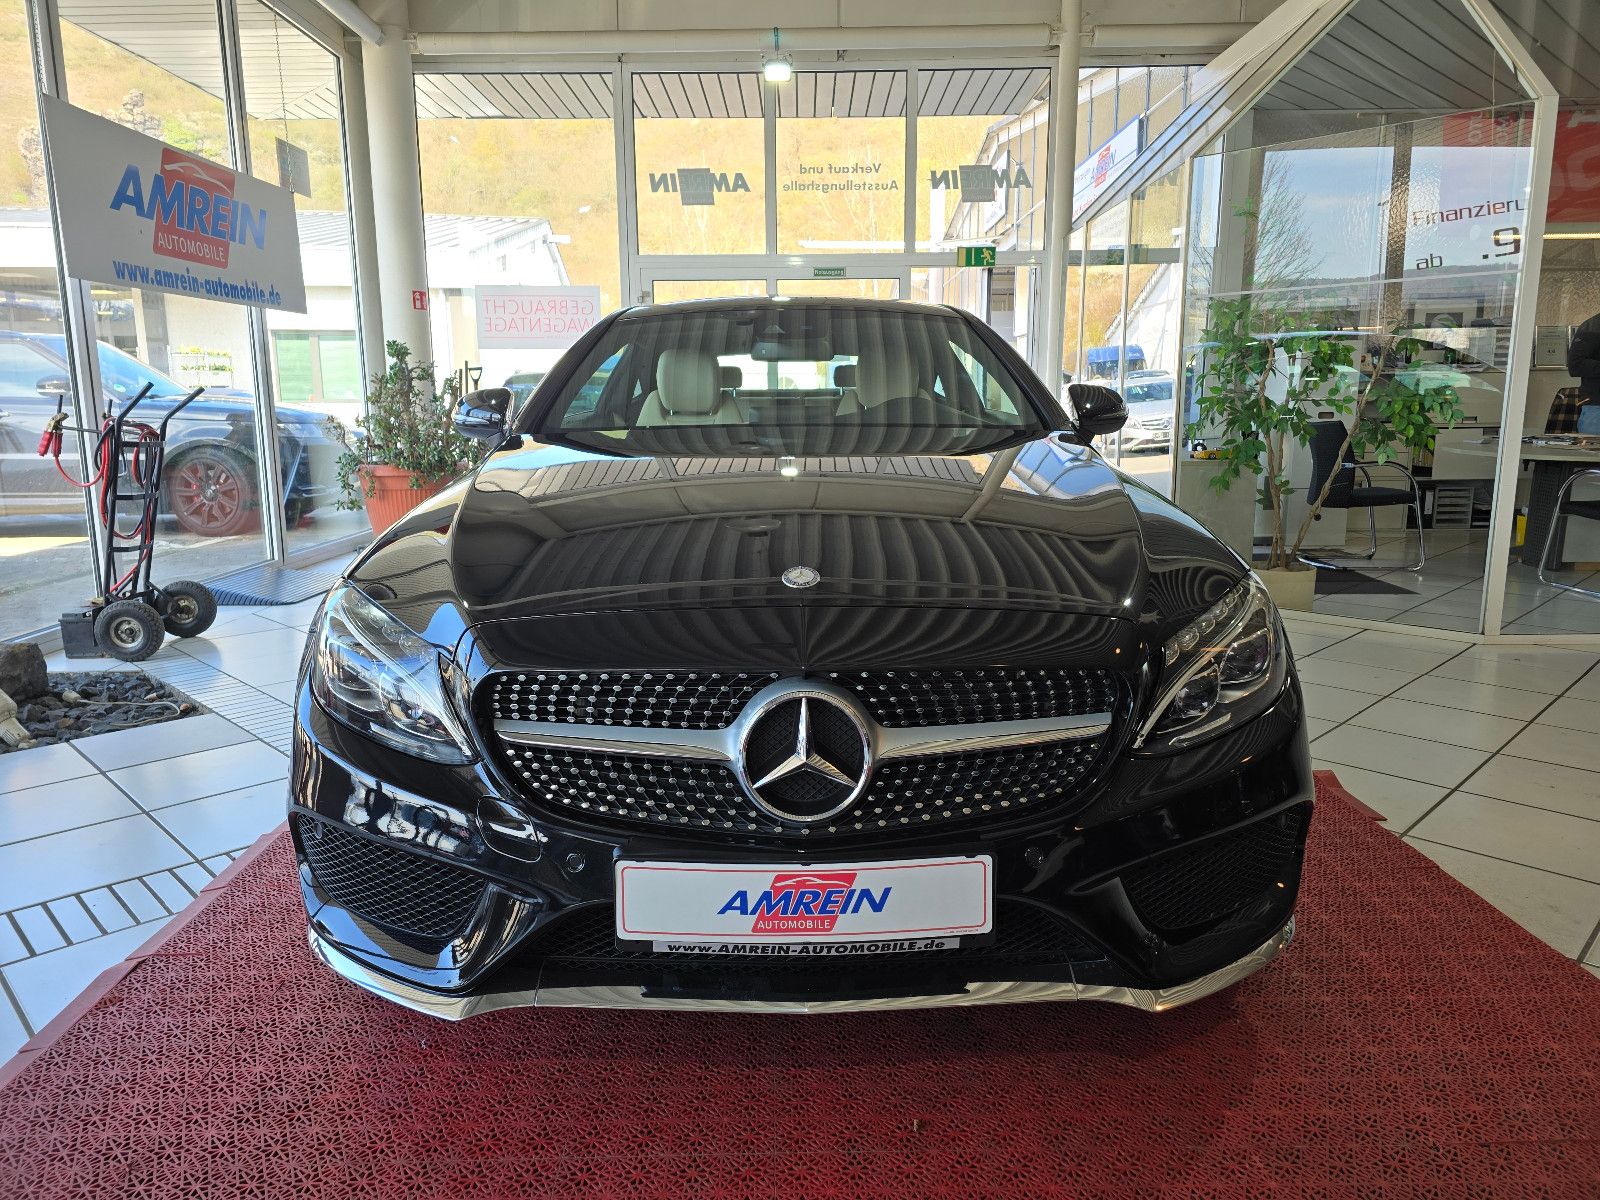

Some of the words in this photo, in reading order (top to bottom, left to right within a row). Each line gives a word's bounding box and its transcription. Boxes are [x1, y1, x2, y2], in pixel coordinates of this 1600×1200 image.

[109, 163, 267, 250] AMREIN
[158, 232, 225, 262] AUTOMOBILE
[1415, 253, 1443, 271] ab
[113, 260, 282, 306] www.amrein-automobile.de
[717, 886, 892, 916] AMREIN
[757, 919, 830, 930] AUTOMOBILE
[667, 940, 946, 955] www.AMREIN-AUTOMOBILE.de
